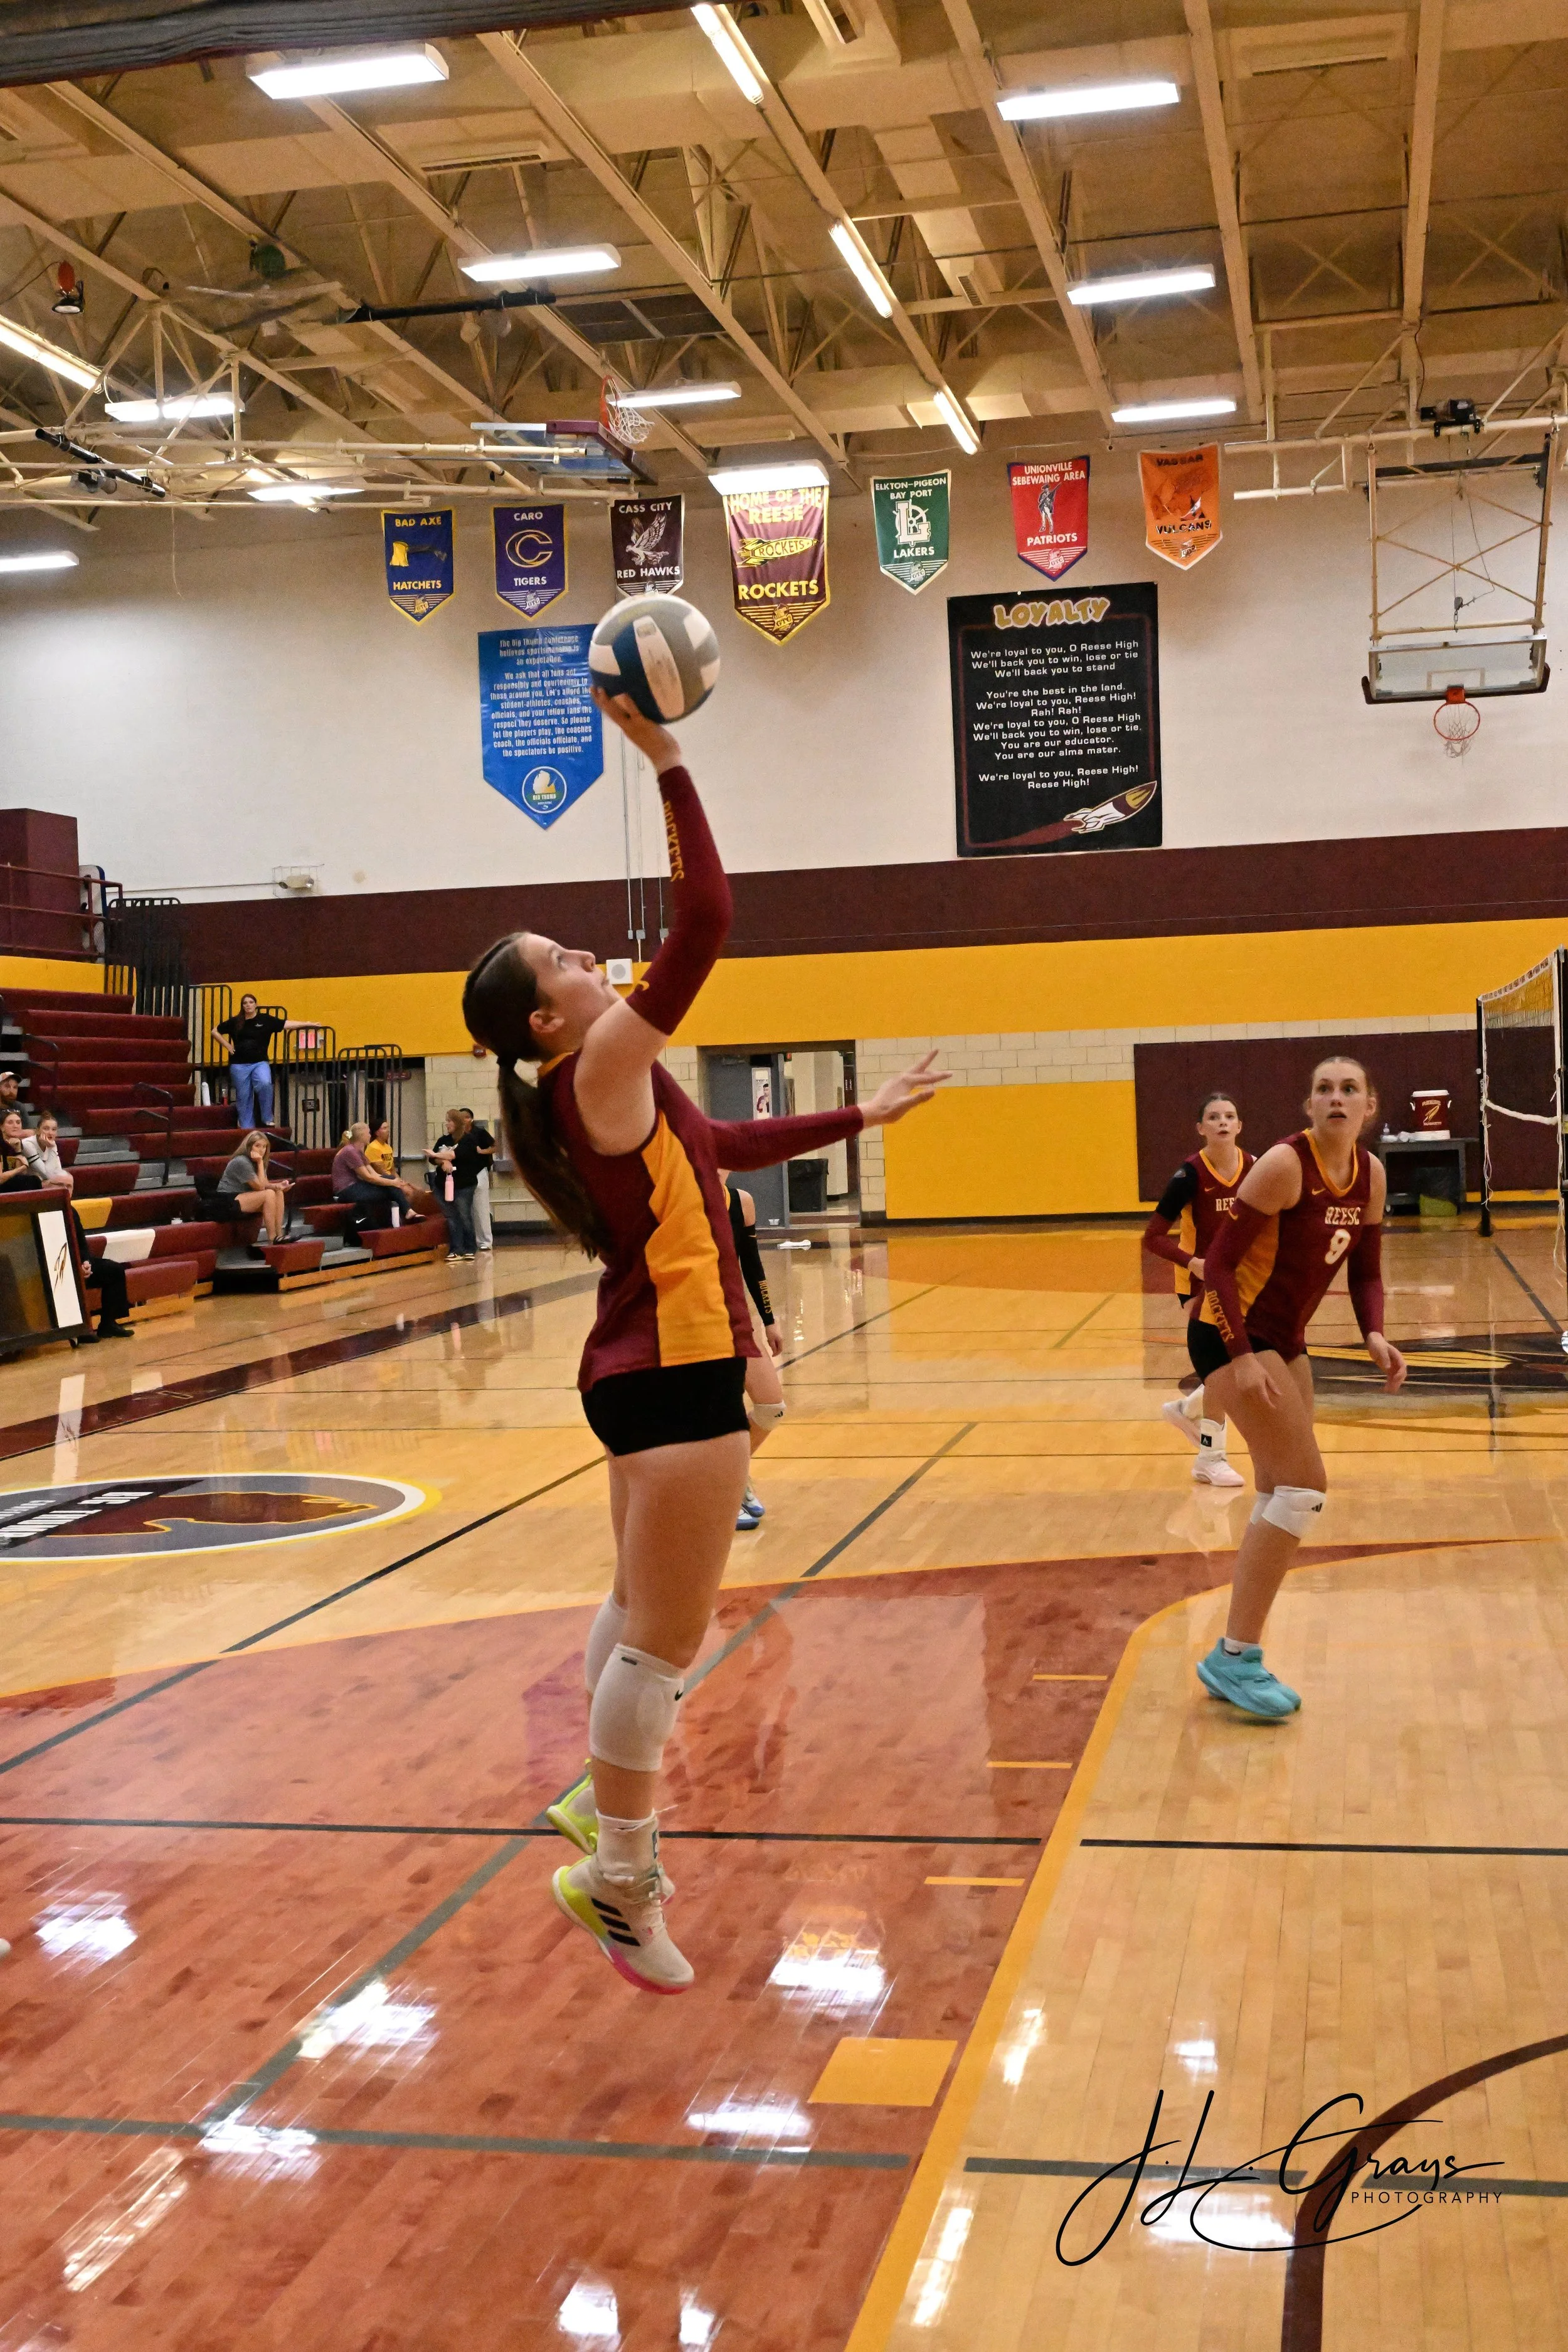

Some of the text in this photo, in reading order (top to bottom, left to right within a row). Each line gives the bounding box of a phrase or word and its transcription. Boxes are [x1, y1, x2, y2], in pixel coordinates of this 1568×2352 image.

[1024, 462, 1073, 475] UNIONVILLE
[875, 477, 946, 490] ELKTON-PIGEON
[1012, 471, 1086, 486] SEBEWAING AREA
[730, 487, 822, 513] HOME OF THE
[910, 489, 932, 498] PORT
[619, 502, 672, 513] CASS CITY
[514, 512, 543, 521] CARO
[749, 506, 803, 524] REESE
[395, 517, 442, 527] BAD AXE
[1156, 520, 1212, 534] VULCANS
[1027, 533, 1078, 546] PATRIOTS
[758, 541, 805, 556] ROCKETS
[894, 547, 935, 558] LAKERS
[1051, 558, 1062, 566] GTC
[617, 566, 680, 578] RED HAWKS
[913, 571, 924, 579] GTC
[393, 580, 442, 590] HATCHETS
[514, 576, 547, 586] TIGERS
[738, 580, 819, 600] ROCKETS
[993, 598, 1110, 629] LOYALTY
[776, 617, 792, 627] GTC
[971, 650, 1000, 659] We're
[1005, 648, 1027, 657] loyal
[1046, 647, 1065, 655] you,
[1116, 640, 1138, 649] High
[972, 660, 997, 669] We'll
[1001, 659, 1024, 667] back
[1027, 659, 1044, 667] you
[995, 669, 1020, 677] We'll
[1024, 667, 1047, 675] back
[1051, 667, 1067, 675] you
[1086, 662, 1115, 671] stand
[987, 691, 1019, 699] You're
[1101, 682, 1125, 691] land.
[976, 701, 1006, 710] We're
[1010, 699, 1032, 709] loyal
[1110, 692, 1135, 702] High!
[1032, 706, 1081, 716] Rah! Rah!
[973, 723, 1004, 731] We're
[1007, 720, 1030, 729] loyal
[1048, 719, 1067, 728] you,
[1118, 713, 1140, 723] High
[973, 733, 998, 741] We'll
[1002, 731, 1025, 739] back
[1065, 737, 1114, 745] educator.
[978, 773, 1009, 781] We're
[1013, 771, 1035, 781] loyal
[1054, 771, 1073, 779] you,
[1112, 765, 1138, 775] High!
[1063, 778, 1089, 788] High!
[1325, 1206, 1361, 1226] REESE
[1207, 1290, 1234, 1342] ROCKETS
